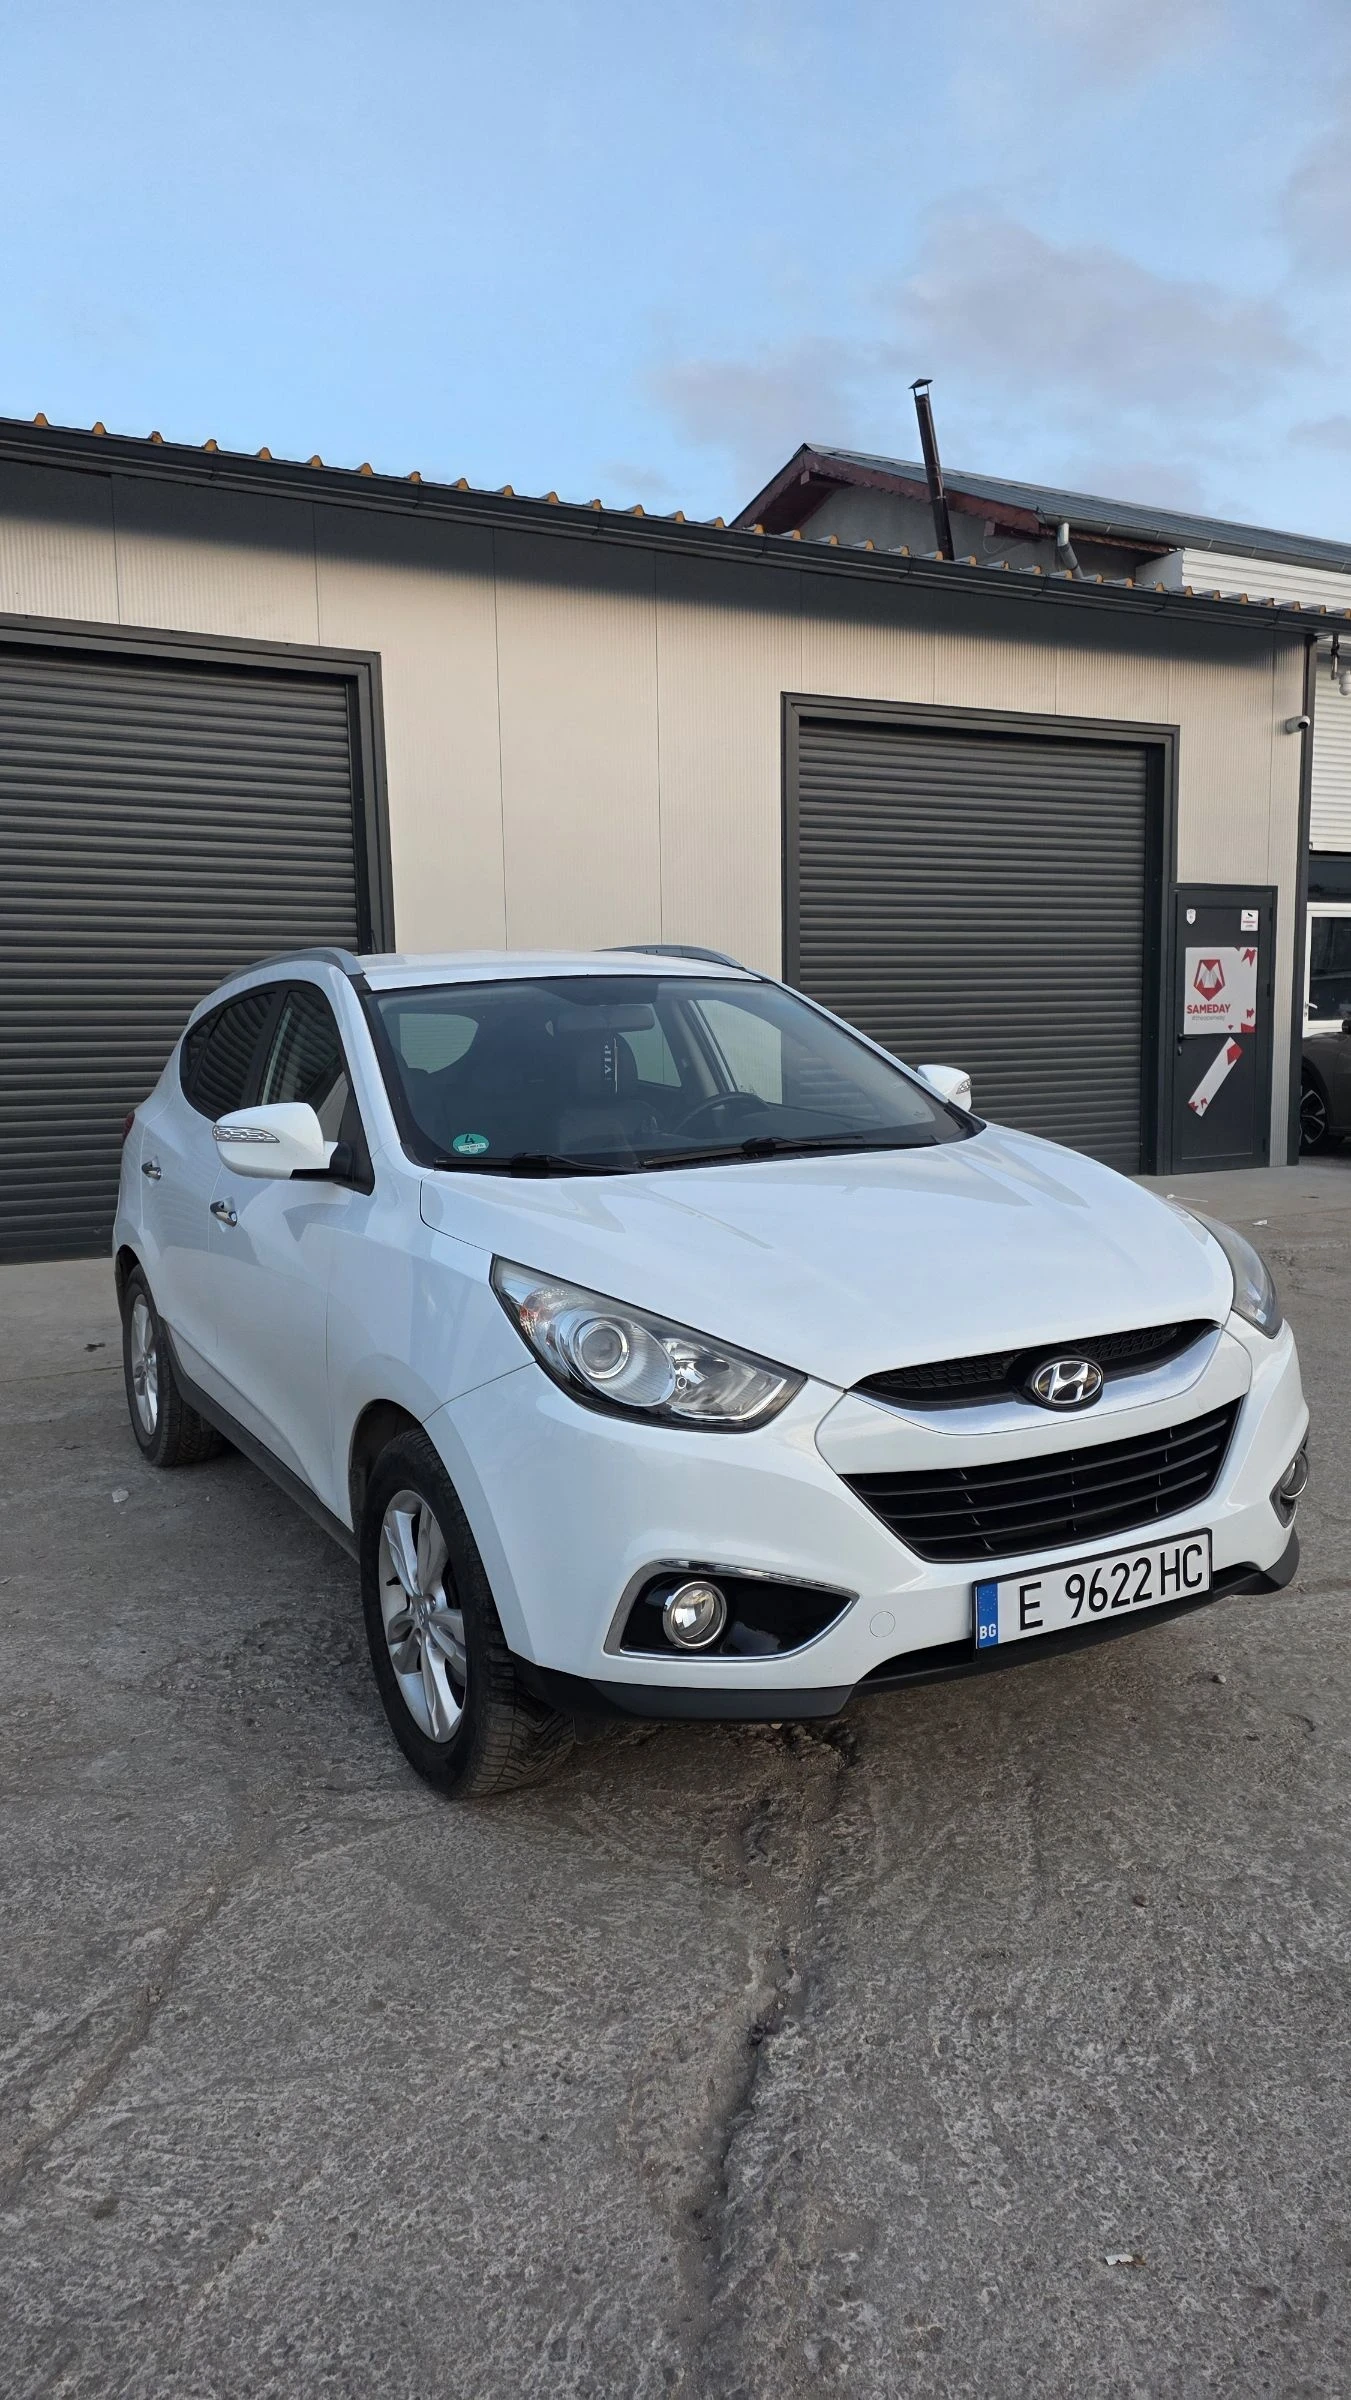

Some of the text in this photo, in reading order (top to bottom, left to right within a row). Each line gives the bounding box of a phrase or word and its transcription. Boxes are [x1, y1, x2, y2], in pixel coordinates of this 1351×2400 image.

[1187, 1004, 1231, 1014] SAMEDAY
[464, 1134, 475, 1144] 4
[1019, 1581, 1044, 1631] E
[1065, 1557, 1153, 1620] 9622
[979, 1623, 997, 1640] BG
